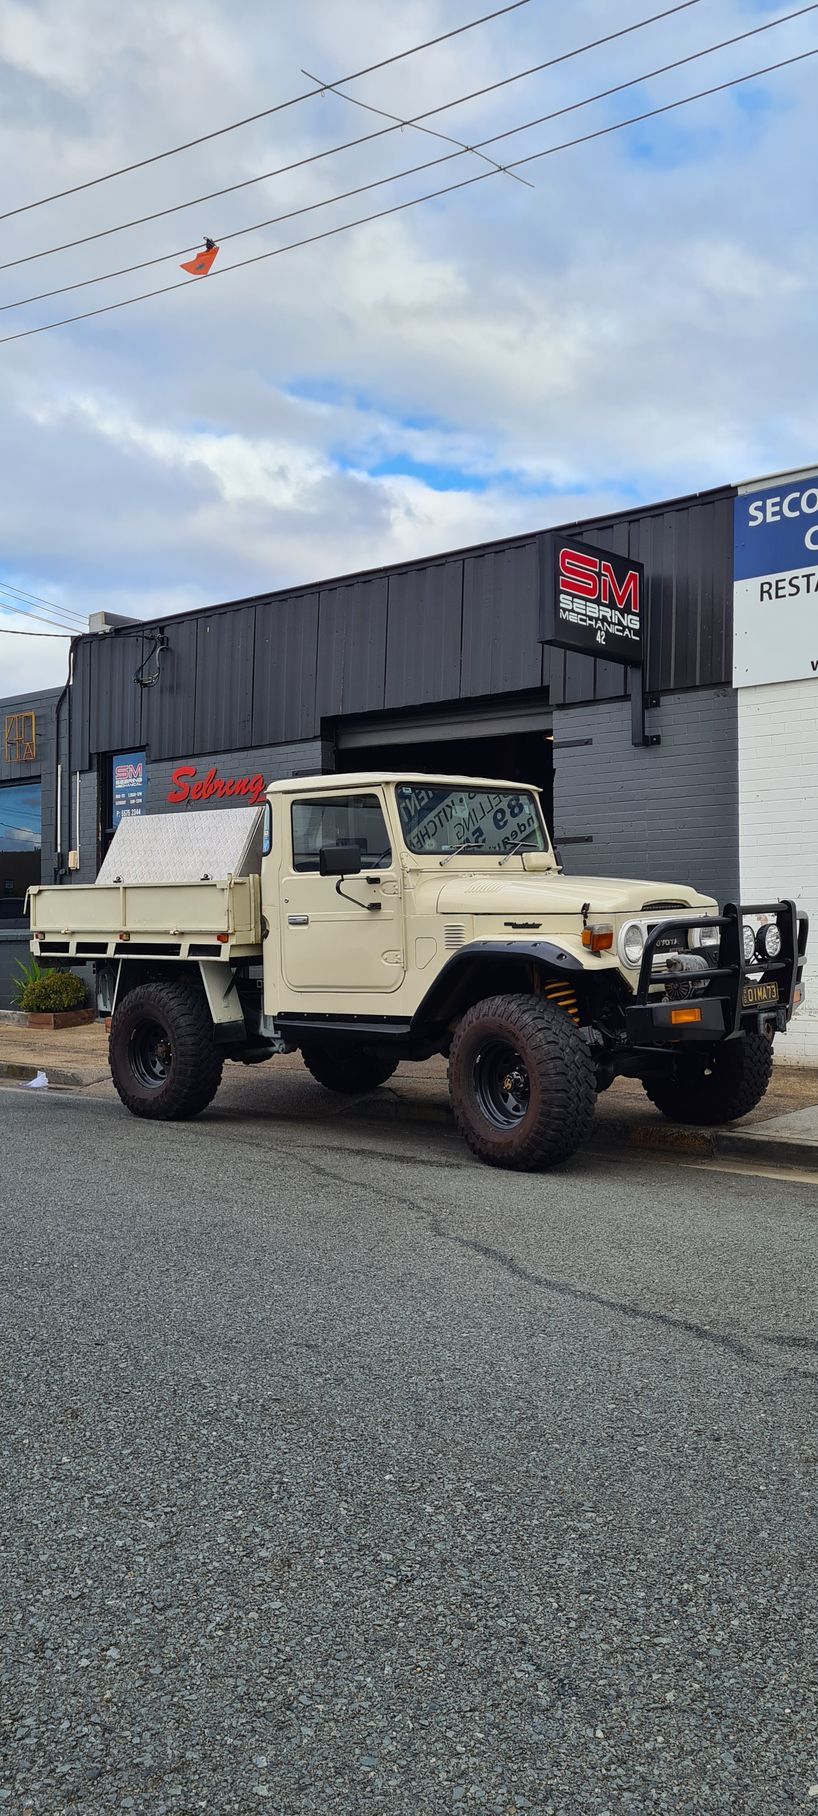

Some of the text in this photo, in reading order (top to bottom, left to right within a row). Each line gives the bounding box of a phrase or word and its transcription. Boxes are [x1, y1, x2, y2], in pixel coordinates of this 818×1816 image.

[559, 548, 640, 613] SM
[559, 594, 640, 630] SEBRING
[559, 609, 640, 641] MECHANICAL
[596, 630, 606, 645] 42
[115, 763, 143, 780] SM
[167, 766, 266, 805] Sebring
